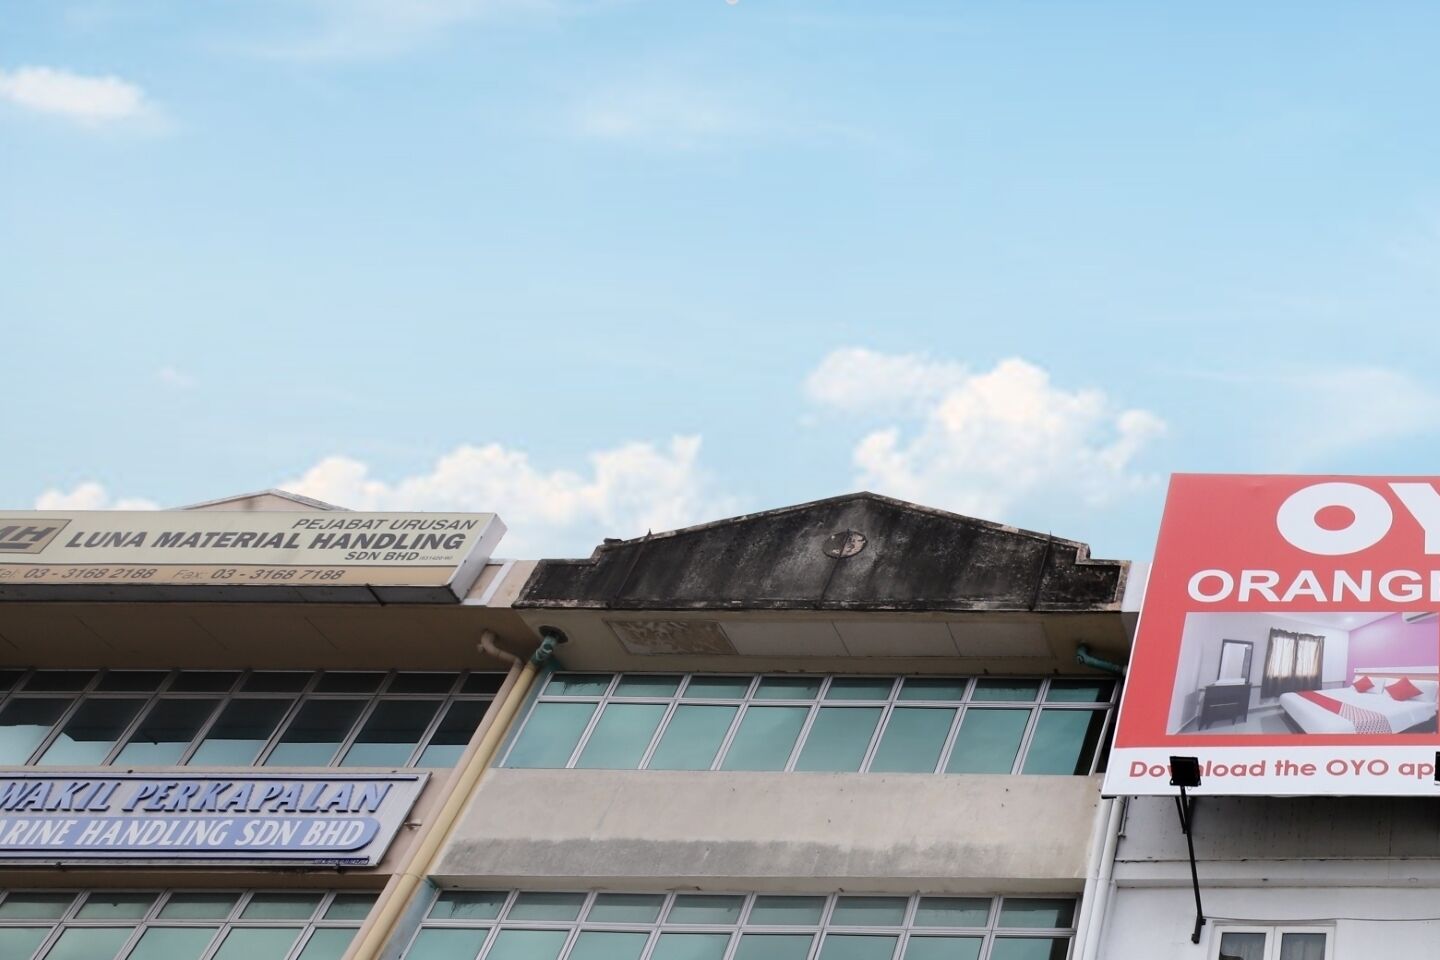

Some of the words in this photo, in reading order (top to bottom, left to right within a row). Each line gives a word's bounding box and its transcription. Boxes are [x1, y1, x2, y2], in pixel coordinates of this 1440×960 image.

[292, 518, 388, 530] PEJABAT
[389, 519, 479, 530] URUSAN
[65, 531, 148, 548] LUNA
[152, 531, 300, 549] MATERIAL
[307, 532, 466, 550] HANDLING
[344, 551, 382, 561] SDN
[382, 551, 419, 561] BHD
[24, 568, 51, 579] 03
[61, 568, 106, 579] 3168
[108, 568, 158, 579] 2188
[210, 569, 237, 579] 03
[249, 569, 298, 580] 3168
[299, 569, 347, 580] 7188
[1129, 759, 1266, 778] Doload
[1274, 759, 1317, 777] the
[1326, 758, 1390, 777] OYO
[1398, 762, 1434, 780] ap
[121, 782, 394, 813] PERKAPALAN
[0, 819, 78, 846] RINE
[74, 819, 237, 847] HANDLING
[234, 819, 302, 847] SDN
[300, 820, 366, 847] BHD
